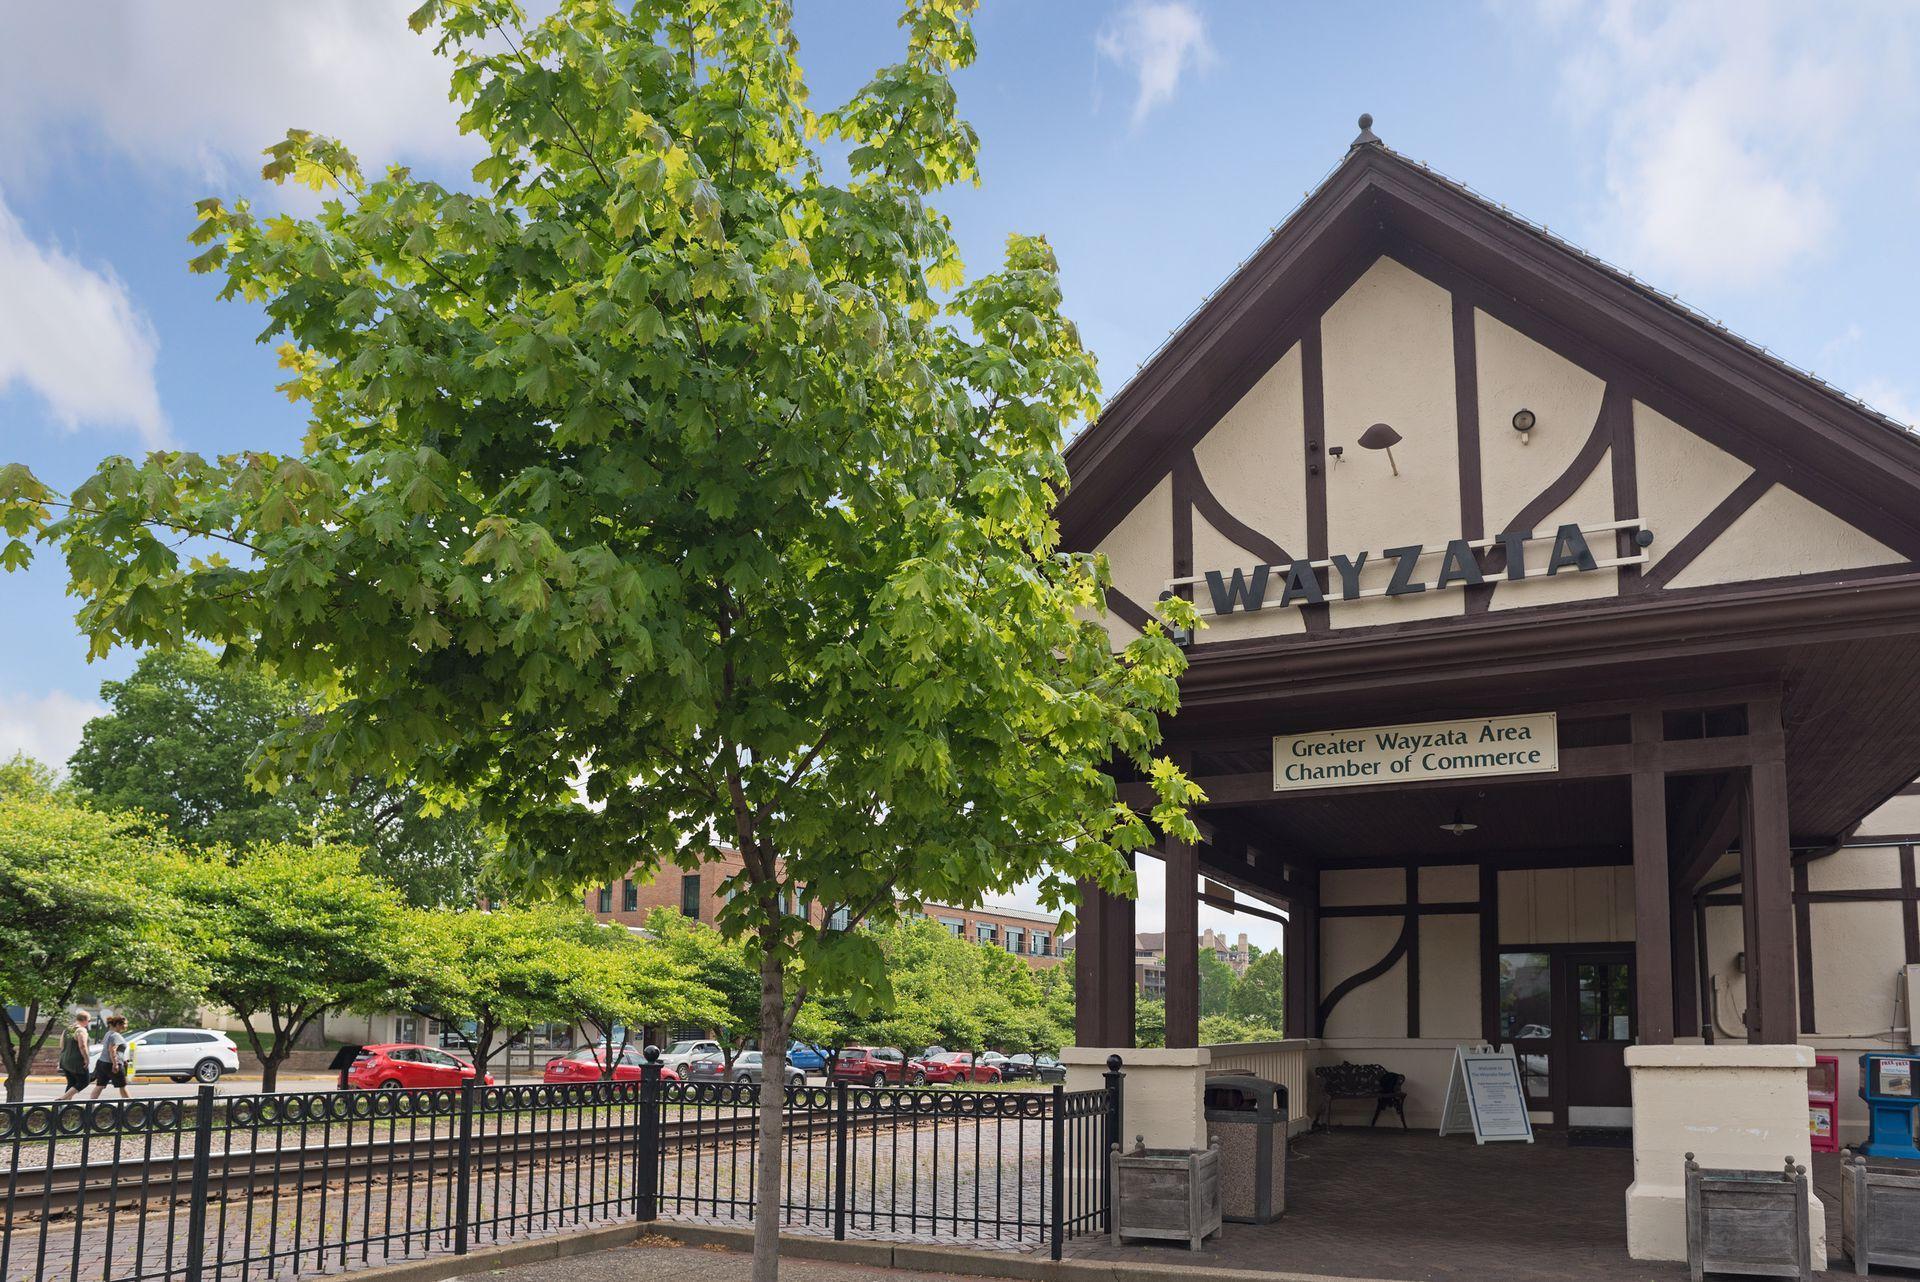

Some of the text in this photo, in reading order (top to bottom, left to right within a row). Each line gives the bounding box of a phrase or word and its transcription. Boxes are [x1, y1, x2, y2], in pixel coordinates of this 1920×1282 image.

[1204, 523, 1598, 615] WAYZATA
[1291, 725, 1532, 757] Greater Wayzata Area
[1285, 750, 1541, 781] Chamber of Commerce
